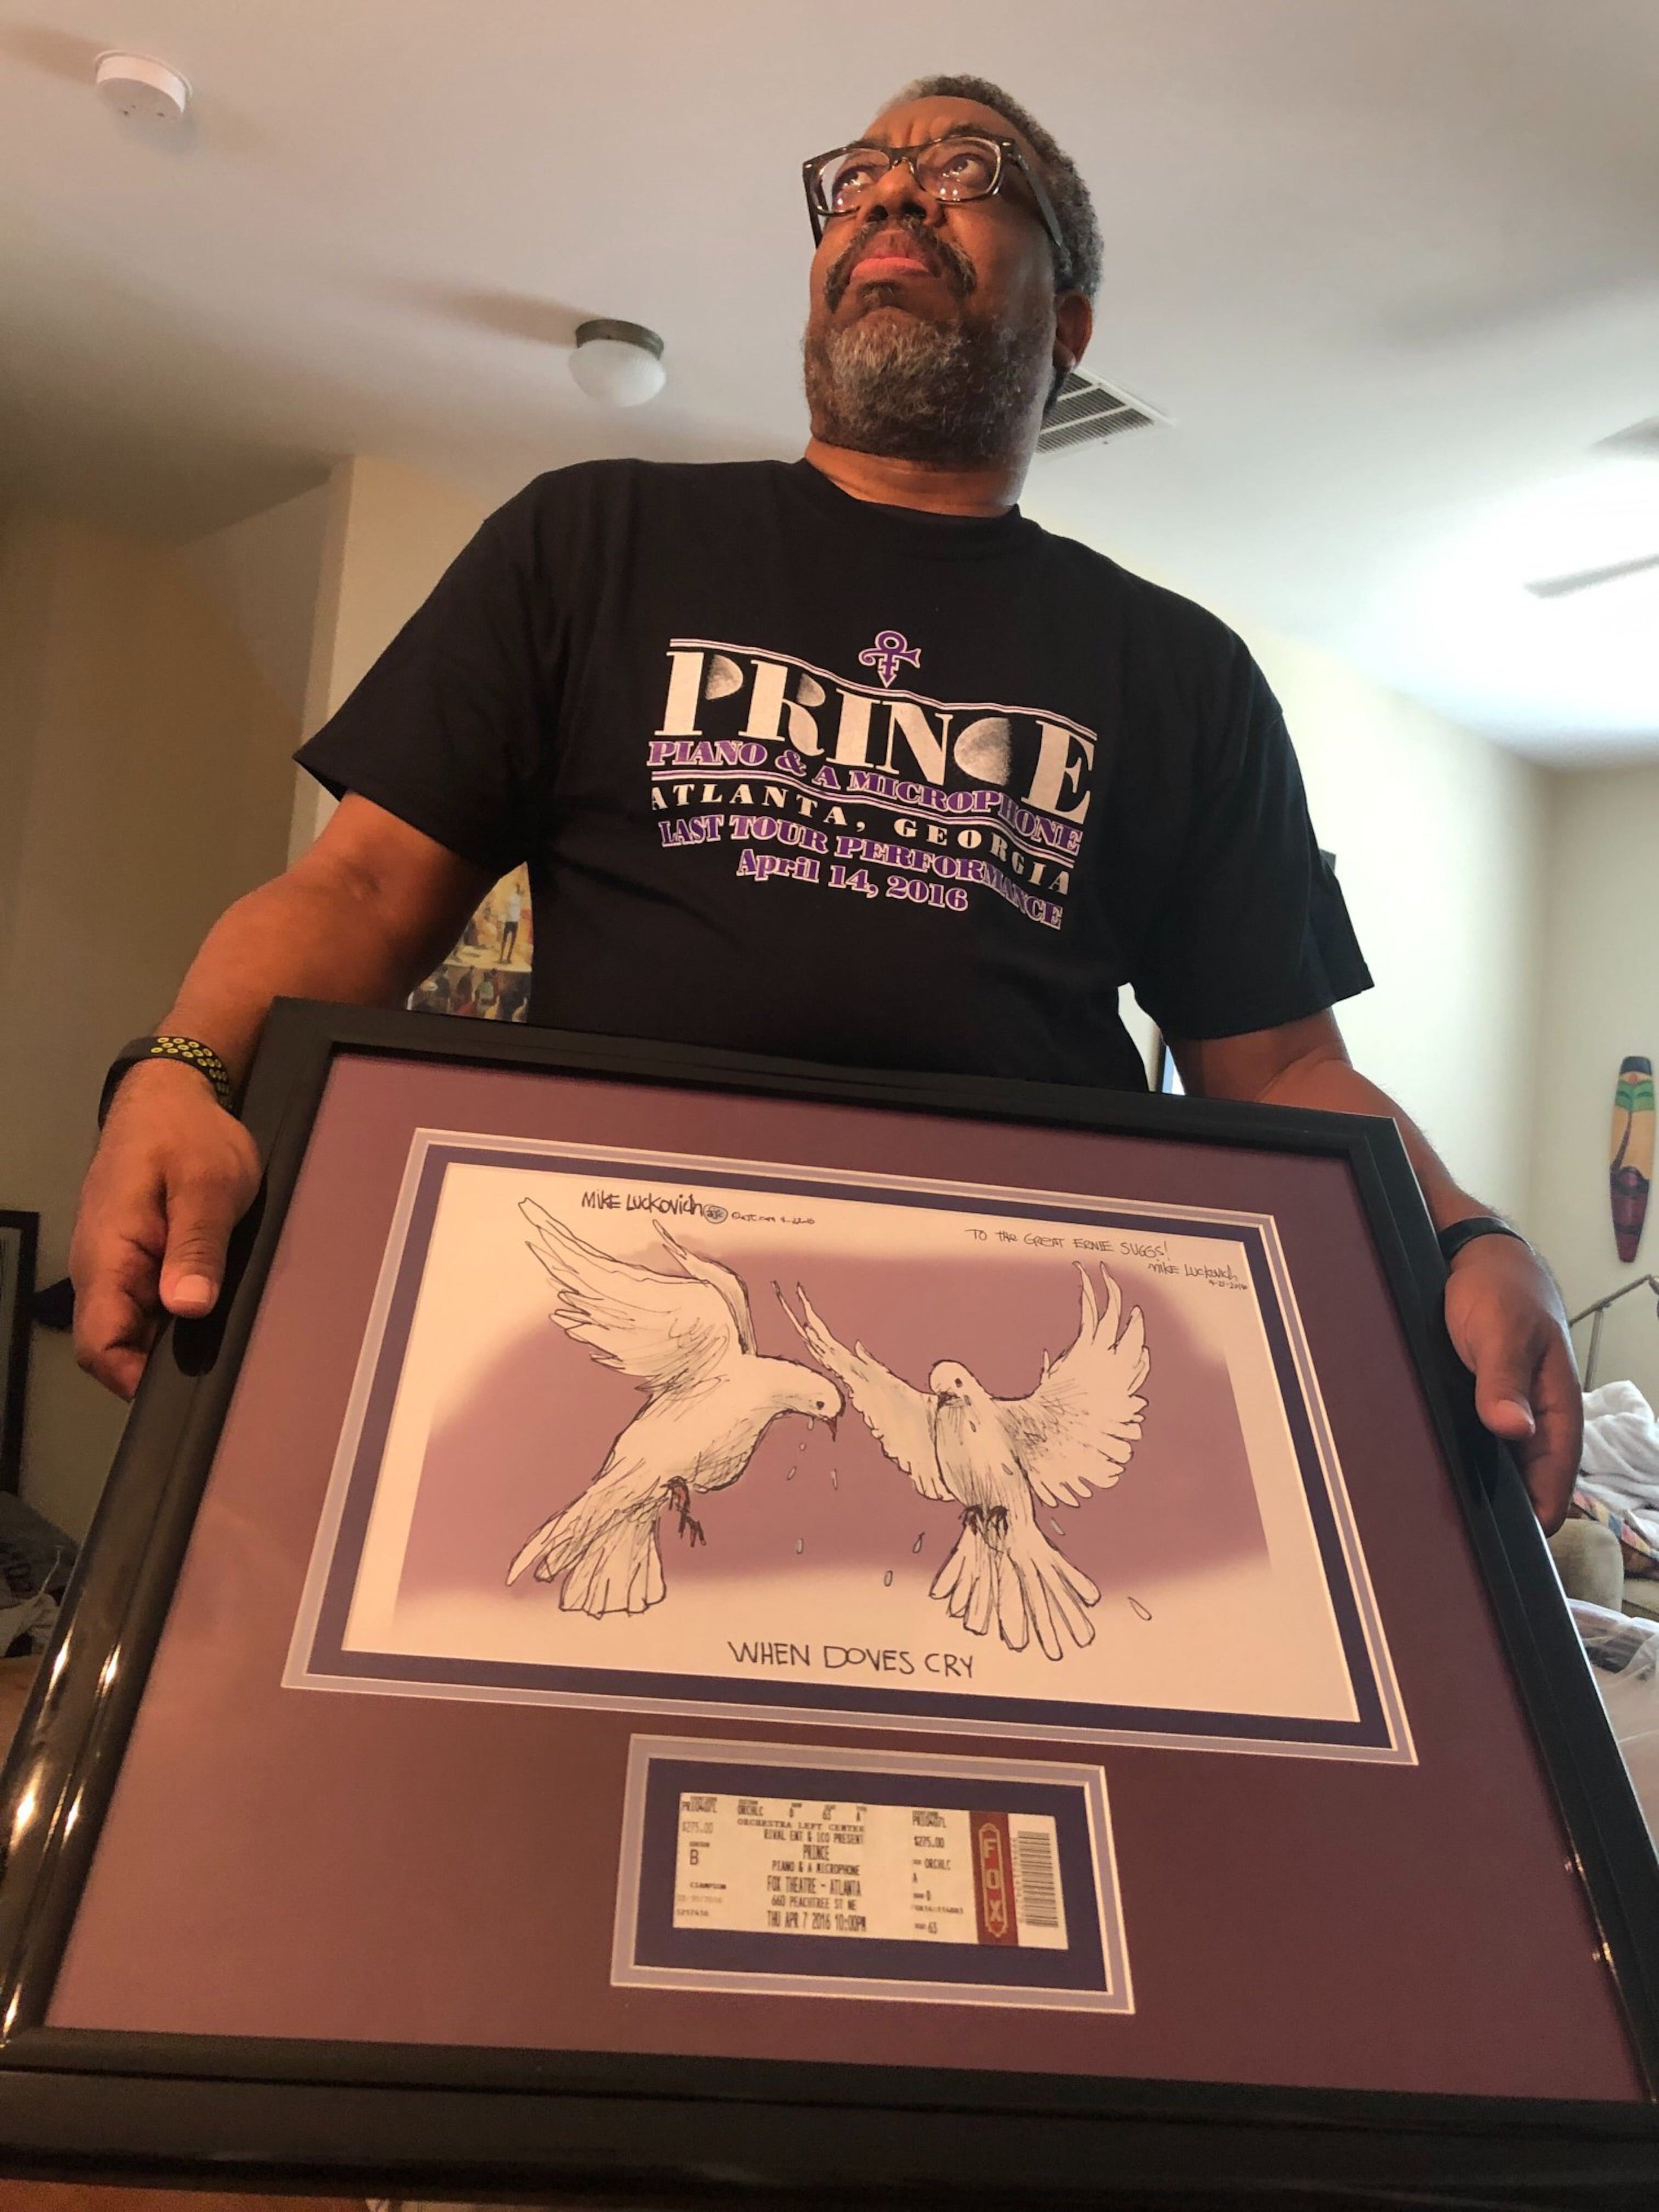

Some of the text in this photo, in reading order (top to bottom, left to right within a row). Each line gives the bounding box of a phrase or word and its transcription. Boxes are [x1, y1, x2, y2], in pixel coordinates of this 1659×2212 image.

[654, 651, 1096, 824] PRINCE
[647, 740, 1084, 856] PIANO & A MICROPHONE
[651, 784, 1070, 896] ATLANTA, GEORGIA
[658, 814, 1064, 930] LAST TOUR PERFORMANCE
[737, 849, 969, 912] April 14, 2016
[1073, 1239, 1114, 1252] ERNIE
[727, 1641, 973, 1678] WHEN DOVES CRY
[737, 1818, 864, 1832] ORCHESTRA LEFT CENTER
[690, 1849, 699, 1865] B
[803, 1844, 830, 1861] PRINCE
[772, 1860, 795, 1872] PIANO
[807, 1862, 812, 1873] A
[816, 1863, 860, 1875] MICROPHONE
[767, 1875, 781, 1892] FOX
[785, 1876, 816, 1894] THEATRE
[830, 1879, 861, 1896] ATLANTA
[983, 1838, 1004, 1922] FOX
[789, 1896, 829, 1909] PEACHTREE
[834, 1898, 843, 1909] ST
[848, 1899, 857, 1910] NE
[767, 1910, 781, 1927] THU
[785, 1912, 798, 1928] APR
[803, 1911, 808, 1928] 7
[812, 1912, 830, 1930] 2016
